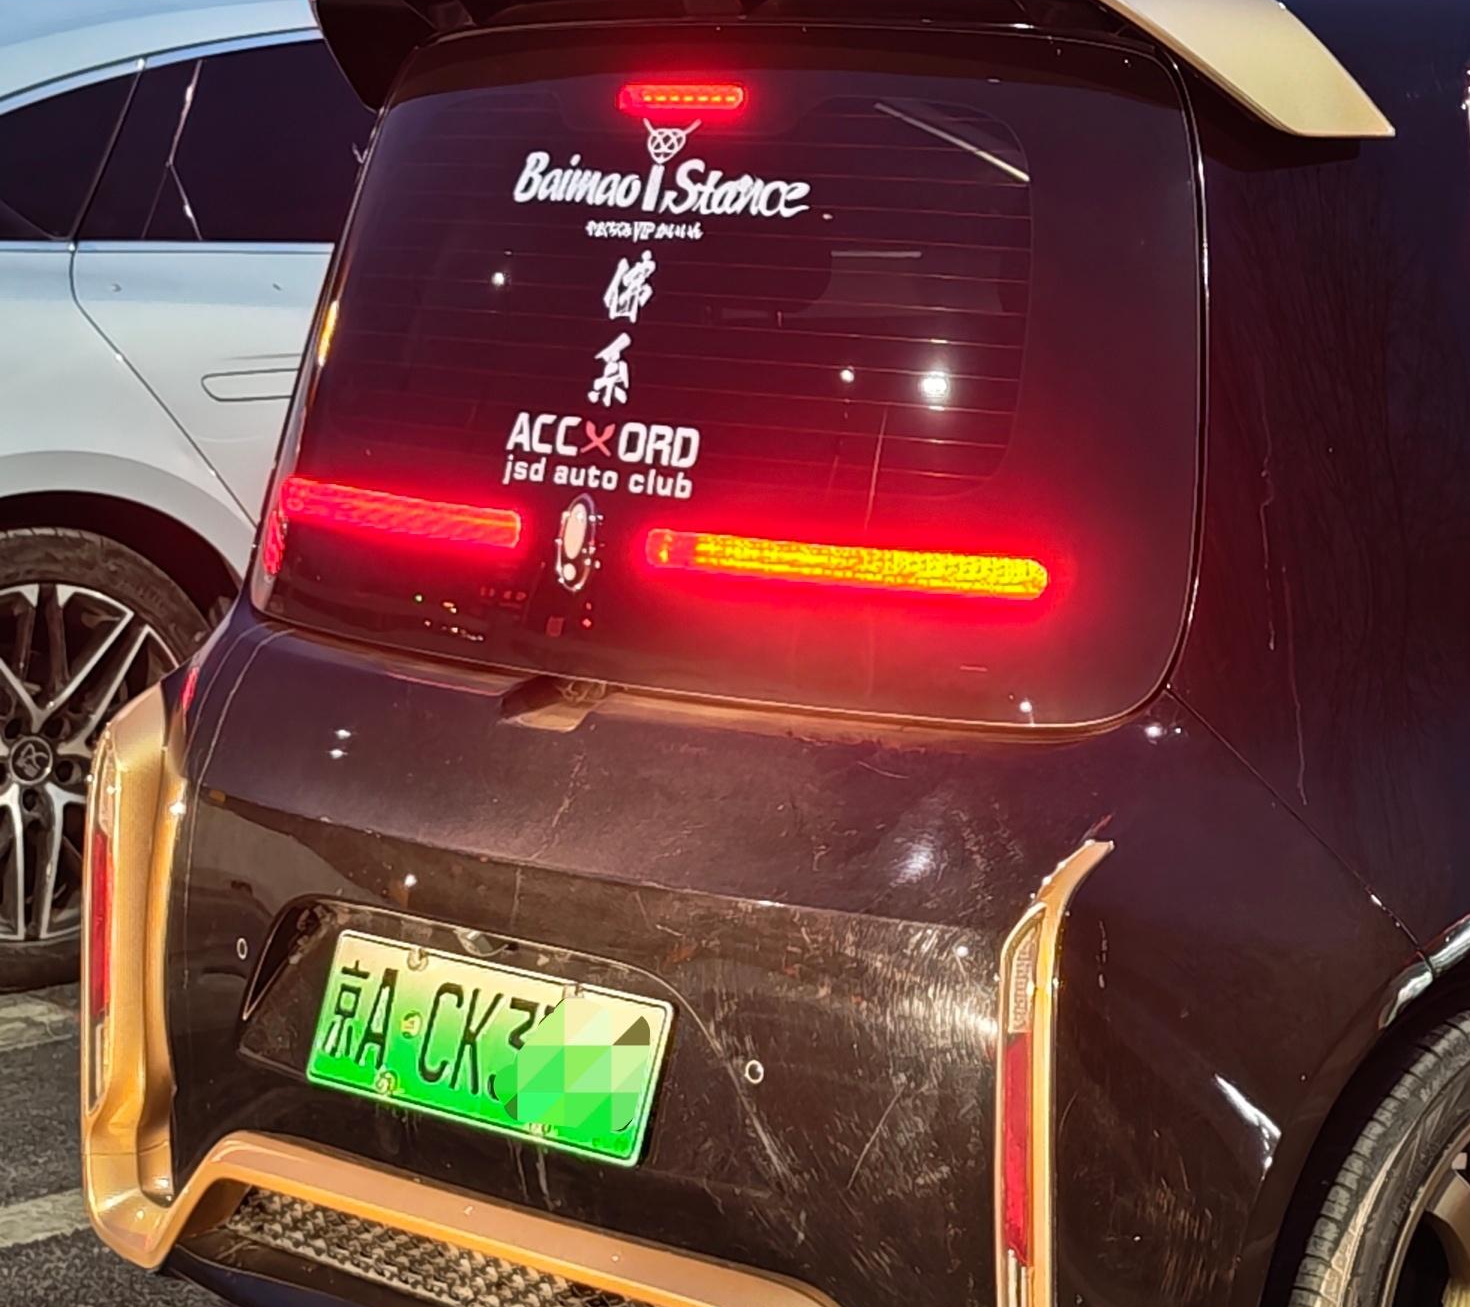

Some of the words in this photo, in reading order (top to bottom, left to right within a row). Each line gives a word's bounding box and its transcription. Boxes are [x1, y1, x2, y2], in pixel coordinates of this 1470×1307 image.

[513, 151, 643, 209] Baimao
[659, 158, 811, 218] Stance
[502, 454, 546, 485] jsd
[553, 465, 619, 491] auto
[627, 467, 693, 500] club
